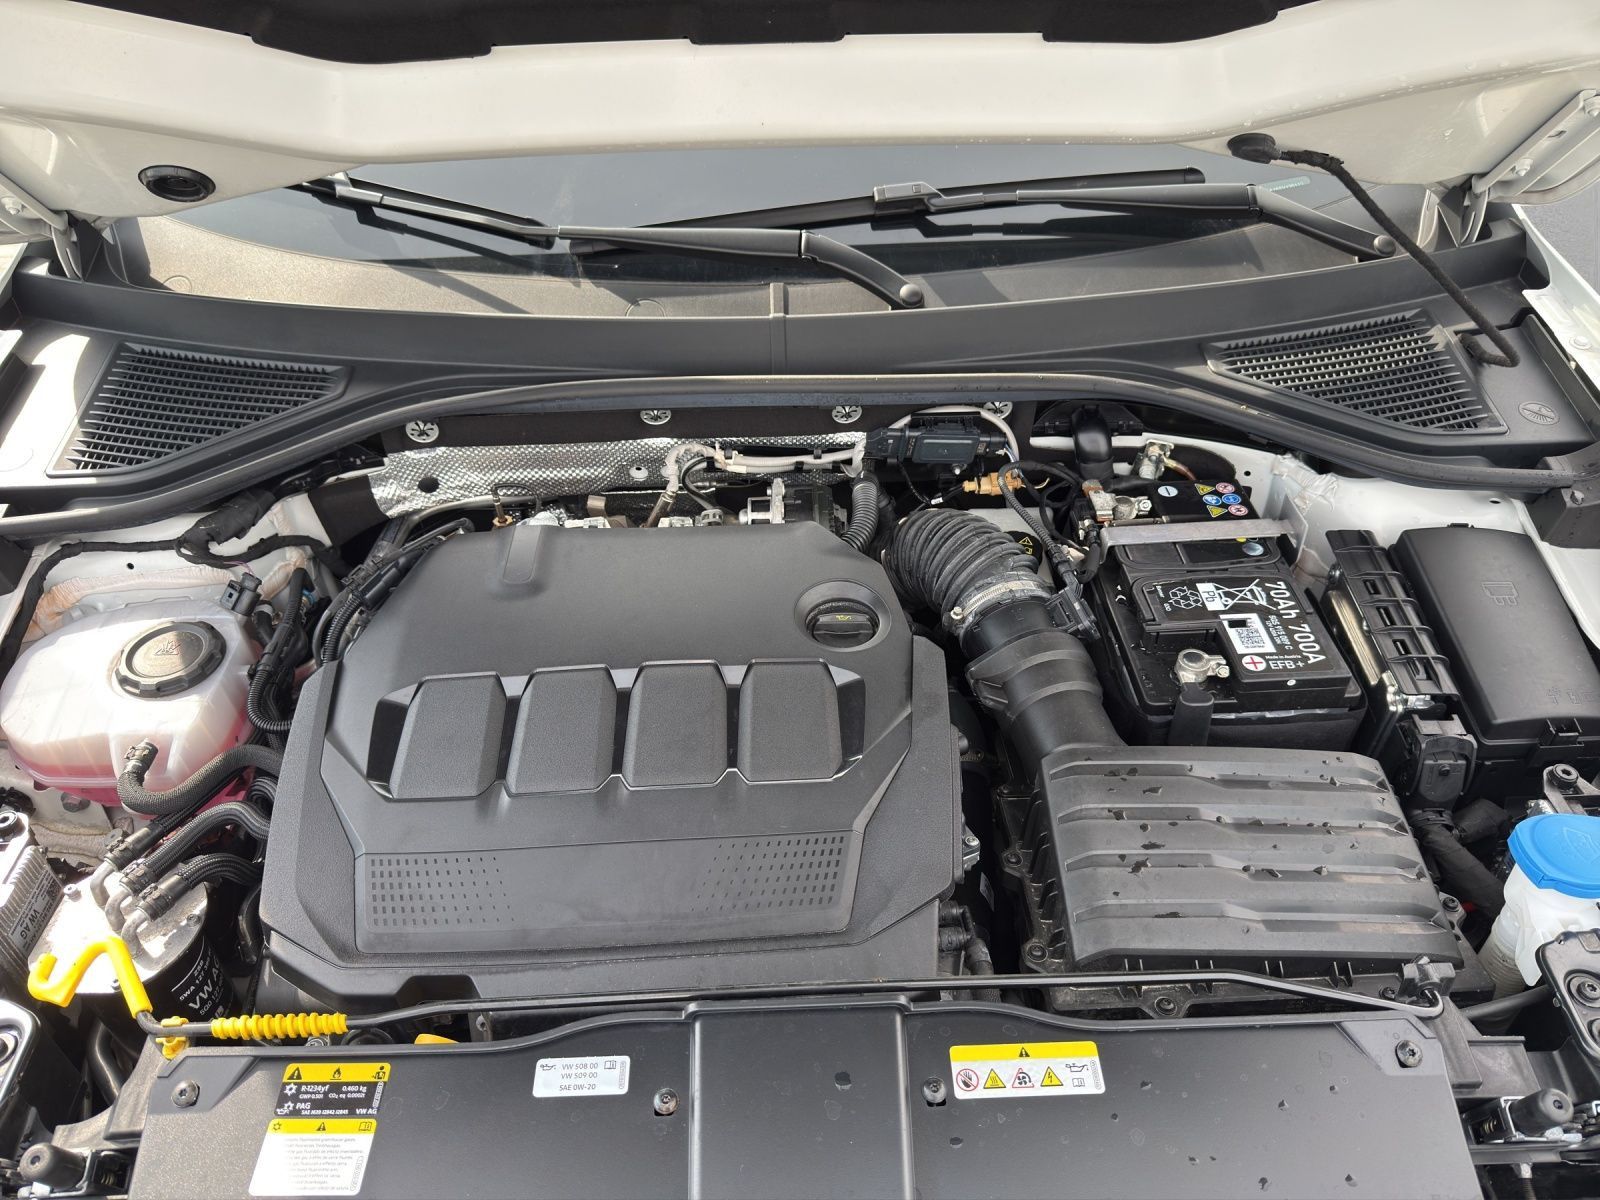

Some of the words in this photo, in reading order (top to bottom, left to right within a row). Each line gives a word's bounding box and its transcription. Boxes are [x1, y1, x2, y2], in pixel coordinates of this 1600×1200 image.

[1202, 591, 1217, 602] Pb
[1265, 581, 1300, 619] 70Ah
[1288, 623, 1326, 664] 700A
[28, 909, 40, 926] VW
[20, 922, 31, 940] AG
[188, 979, 213, 1009] VW
[300, 1084, 330, 1093] R-1234yf
[359, 1085, 367, 1093] kg
[573, 1083, 597, 1091] 0W-20
